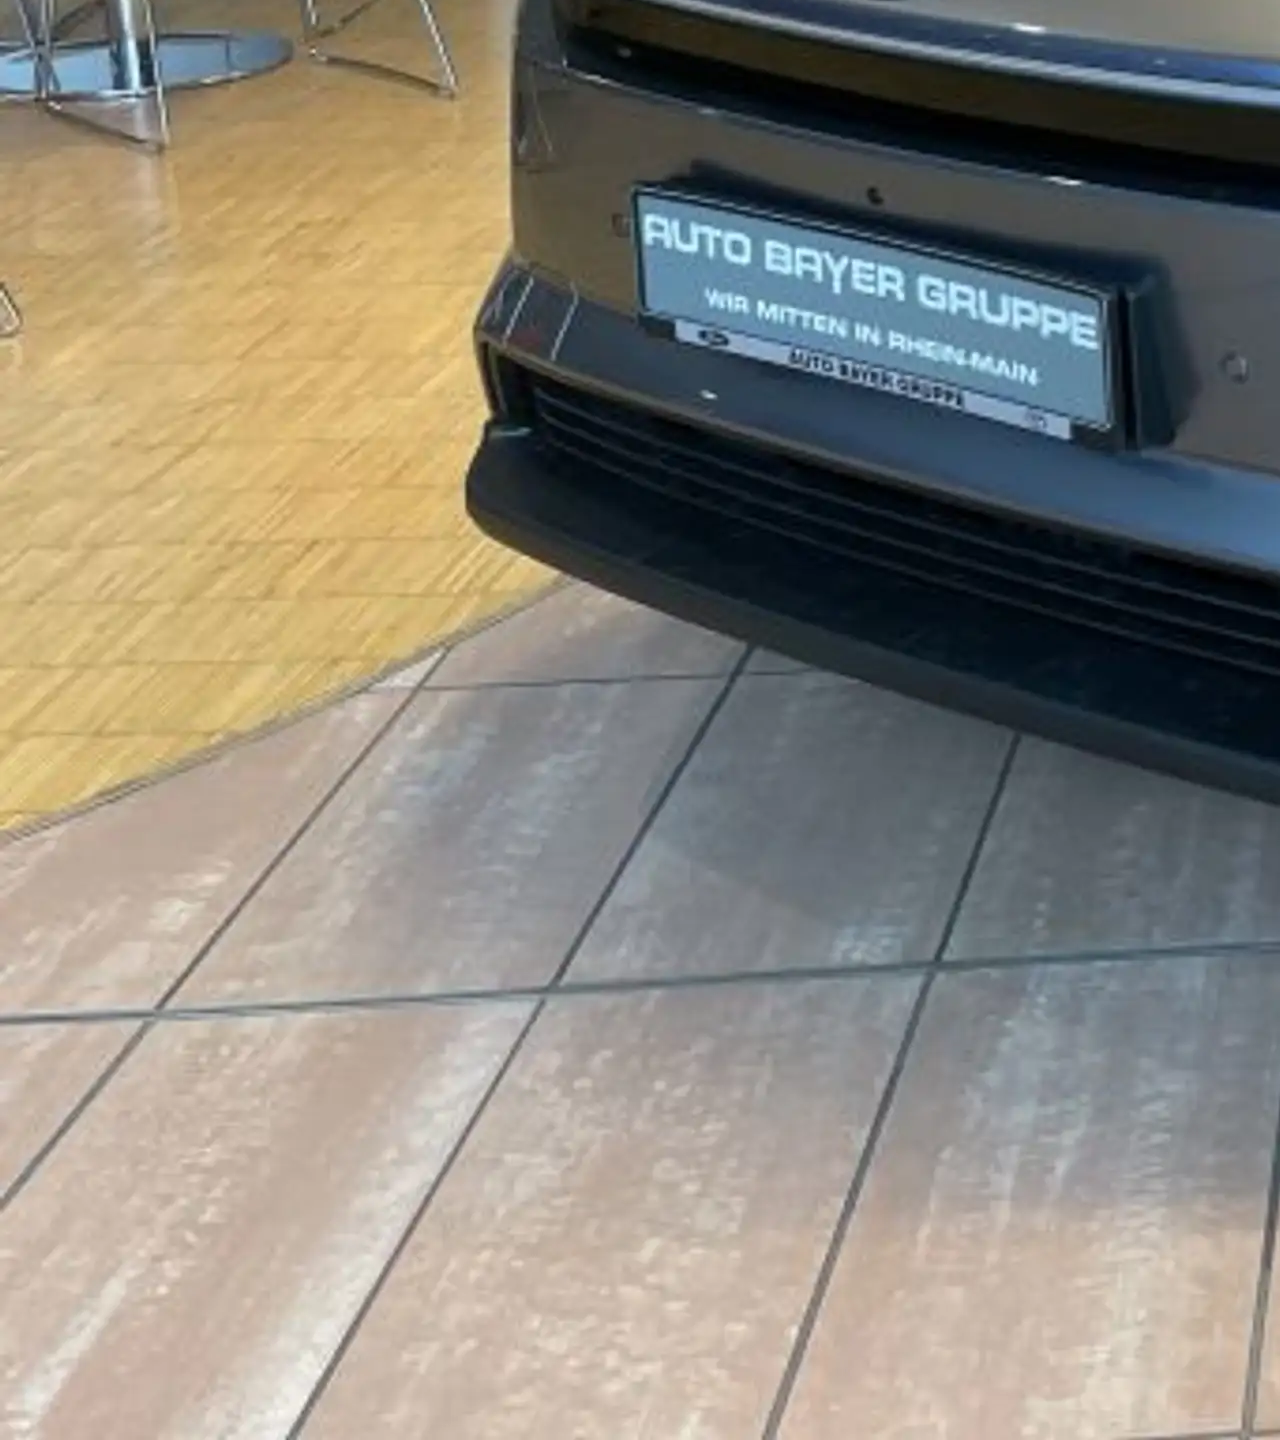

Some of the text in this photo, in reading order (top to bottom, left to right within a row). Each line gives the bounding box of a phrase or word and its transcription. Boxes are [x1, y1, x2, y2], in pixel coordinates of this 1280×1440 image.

[642, 212, 1100, 351] AUTO BAYER GRUPPE
[704, 286, 750, 315] WIR
[756, 299, 848, 338] MITTEN
[854, 322, 882, 347] IN
[889, 328, 1039, 387] RHEIN-MAIN
[789, 348, 834, 374] AUTO
